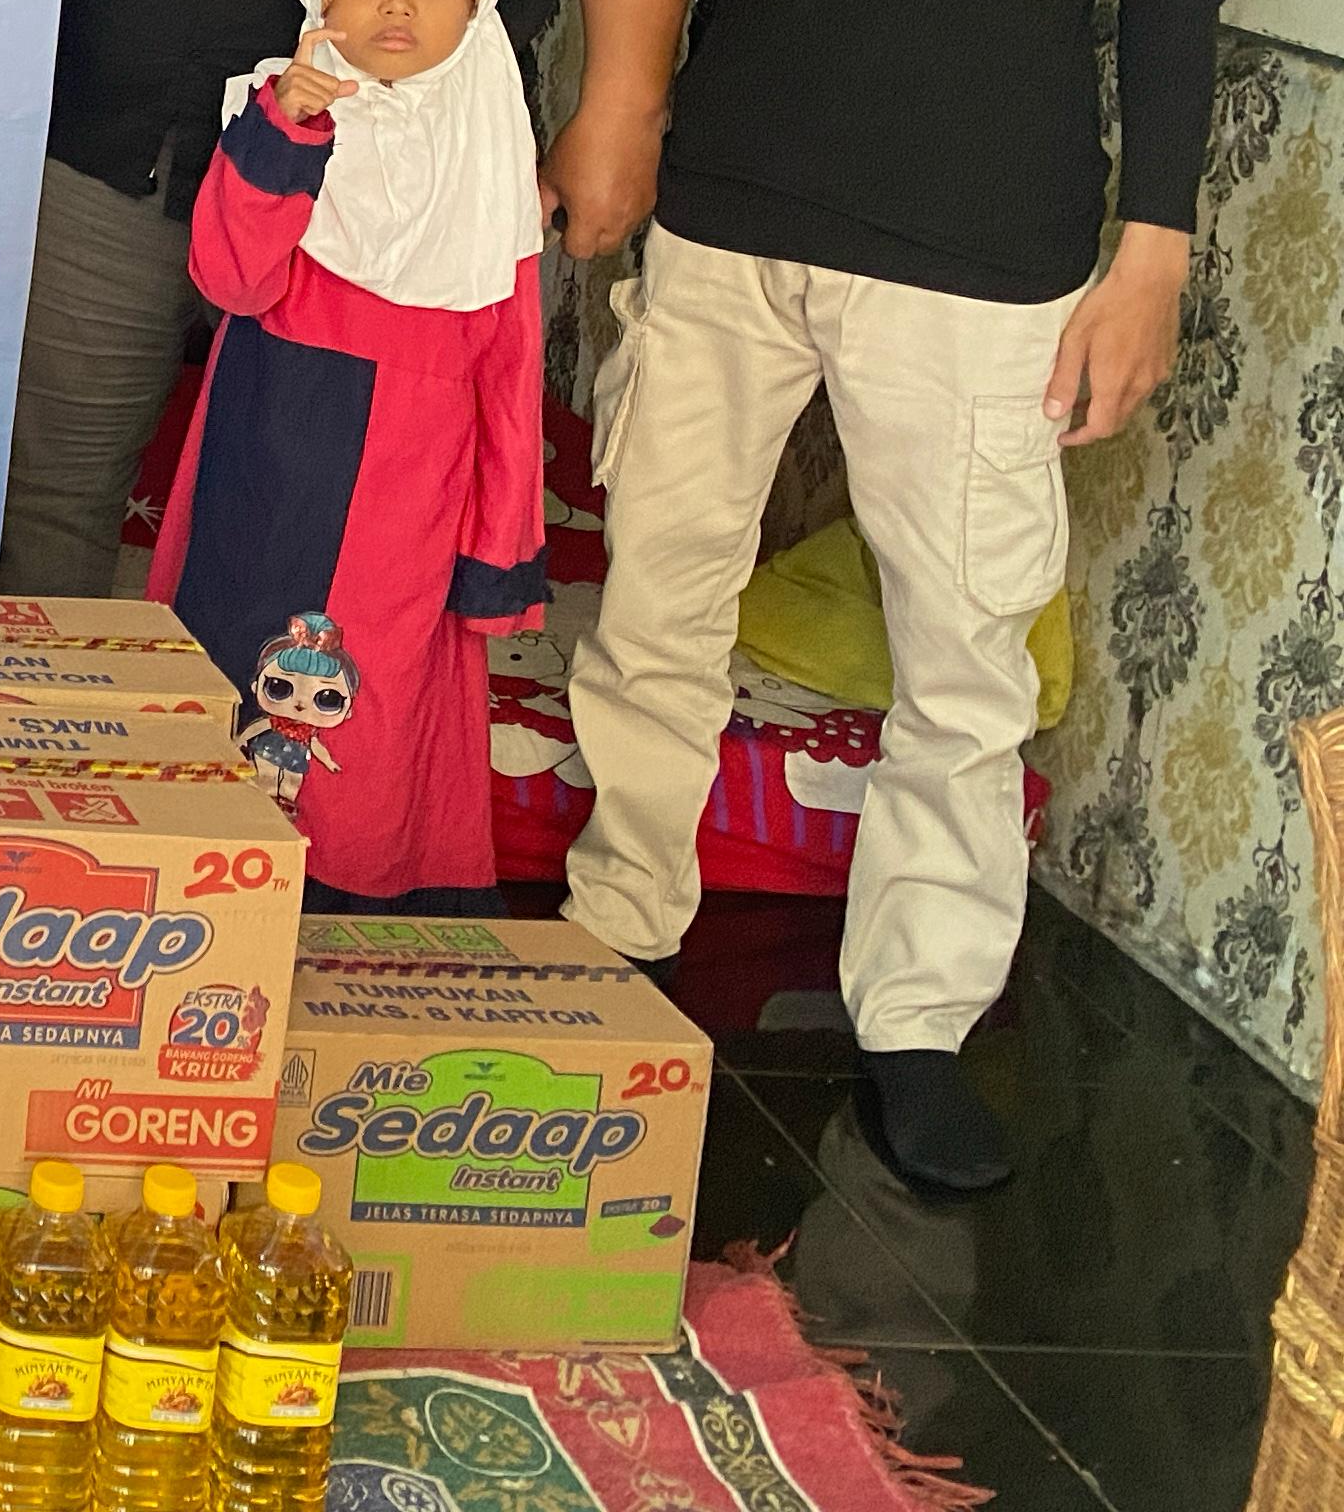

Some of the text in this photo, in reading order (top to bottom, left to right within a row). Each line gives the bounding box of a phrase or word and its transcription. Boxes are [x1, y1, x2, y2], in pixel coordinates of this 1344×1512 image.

[9, 718, 129, 737] MAKS.
[2, 776, 41, 788] seal
[46, 778, 116, 792] broken
[334, 983, 534, 1003] TUMPUKAN
[304, 1001, 418, 1020] MAKS.
[461, 1007, 602, 1026] KARTON
[22, 1025, 124, 1045] SEDAPNYA
[165, 1048, 210, 1060] BAWANG
[170, 1062, 242, 1080] KRIUK
[352, 1066, 428, 1091] Mie
[77, 1082, 110, 1100] MI
[66, 1104, 259, 1147] GORENG
[301, 1094, 644, 1173] Sedaap
[453, 1168, 560, 1190] Instant
[365, 1206, 573, 1225] JELAS TERASA SEDAPNYA
